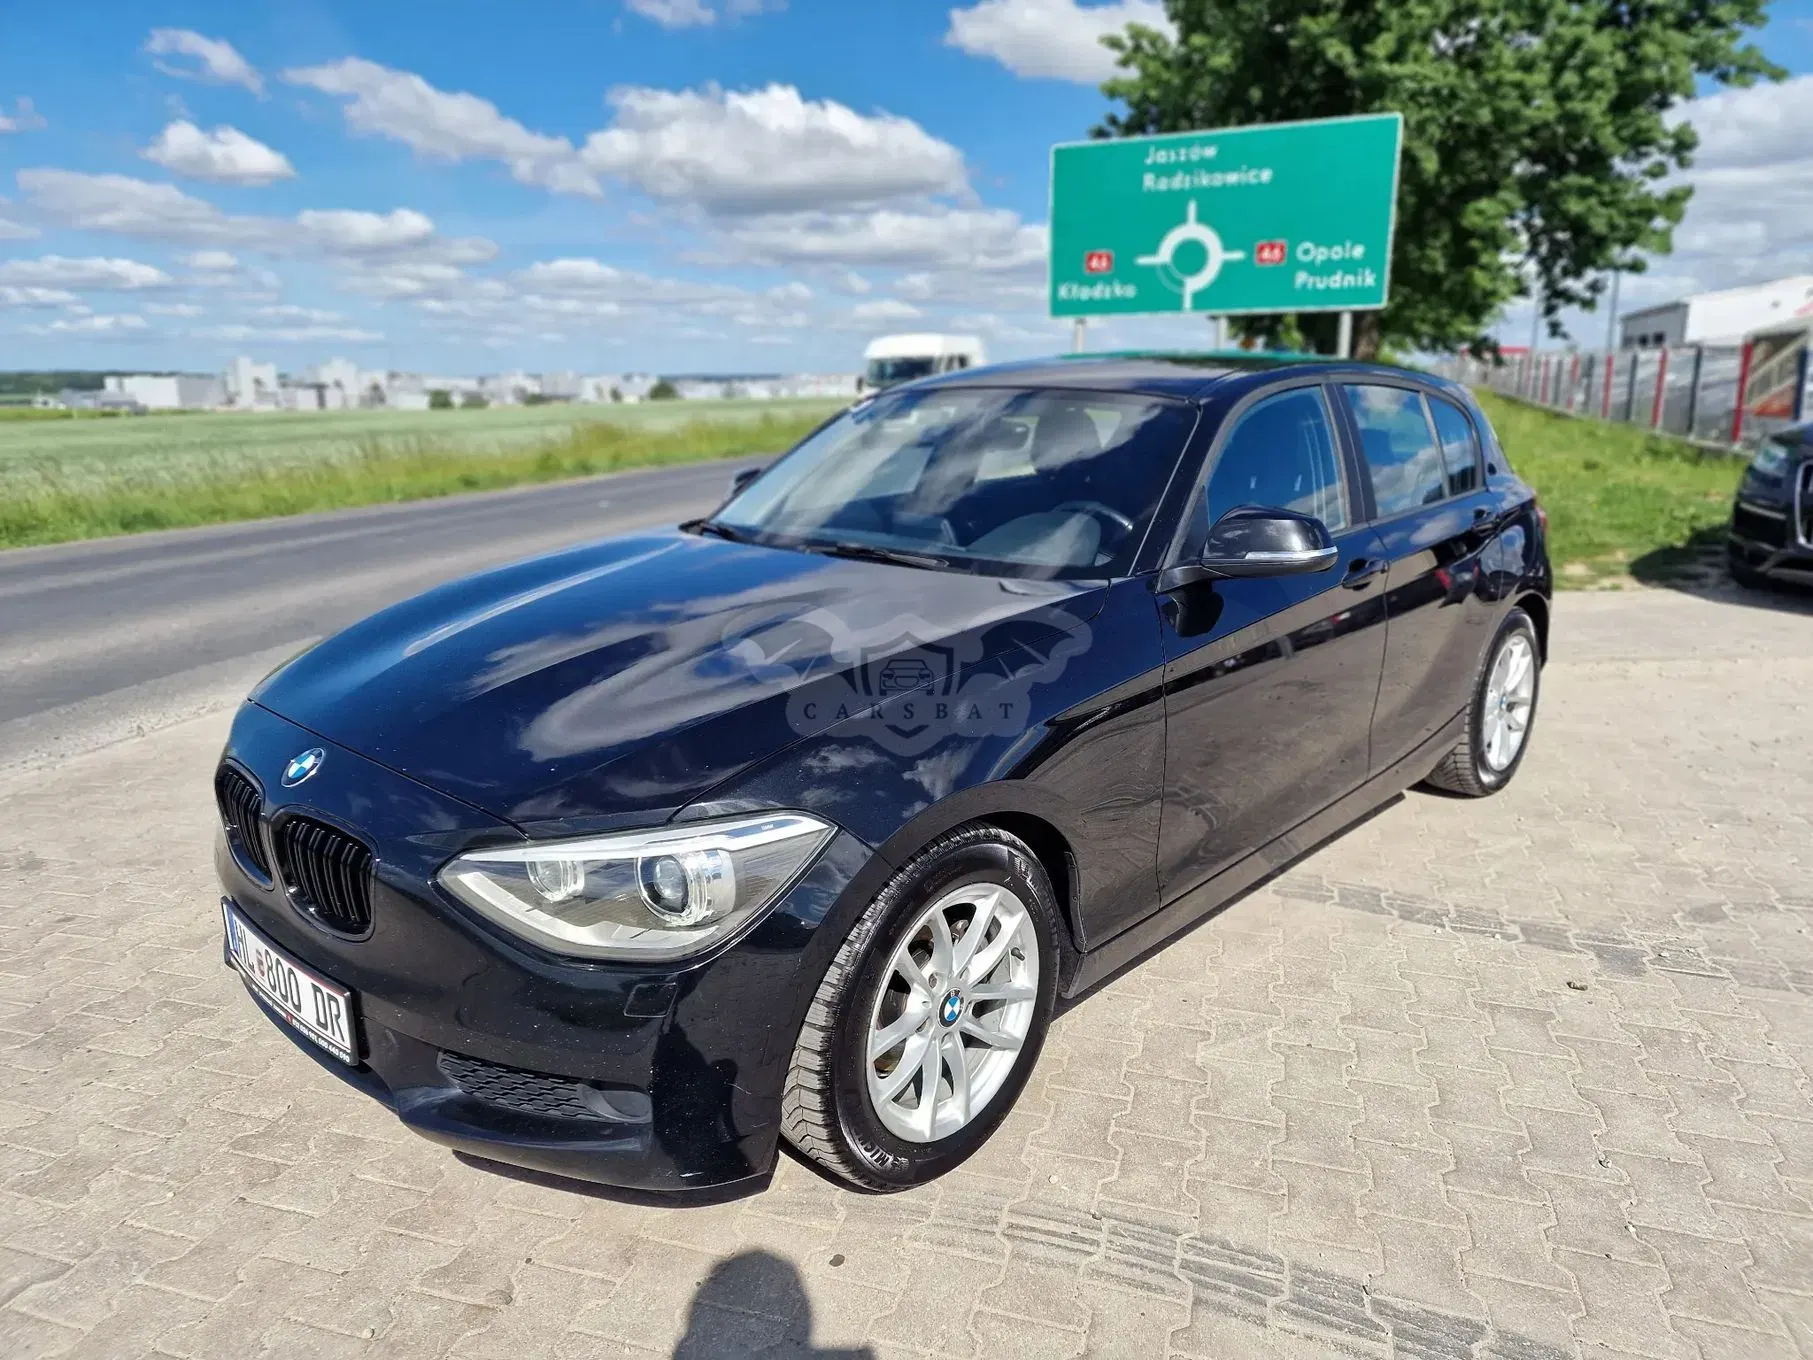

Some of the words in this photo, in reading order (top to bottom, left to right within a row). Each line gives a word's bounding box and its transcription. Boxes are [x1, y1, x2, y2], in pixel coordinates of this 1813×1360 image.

[1142, 165, 1273, 192] Radzikowice
[1296, 240, 1365, 267] Opole
[1294, 267, 1377, 290] Prudnik
[264, 948, 302, 1013] 800
[312, 983, 345, 1042] DR
